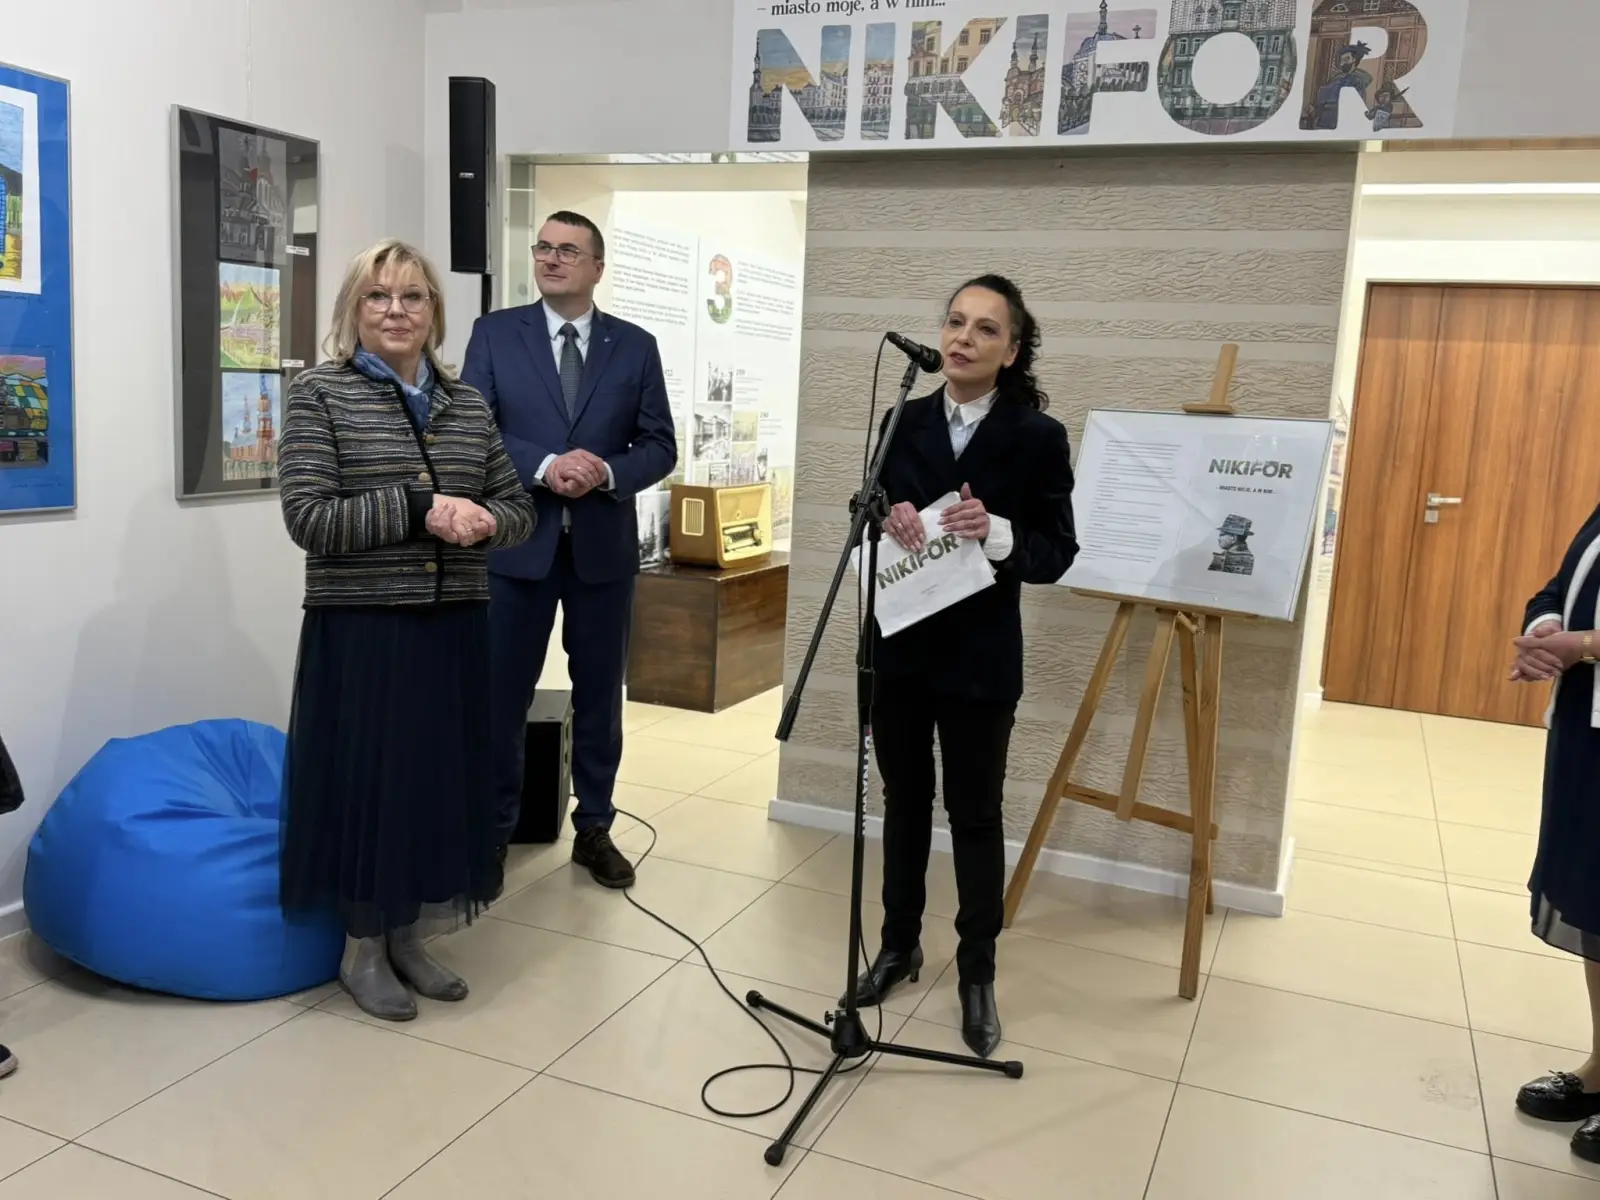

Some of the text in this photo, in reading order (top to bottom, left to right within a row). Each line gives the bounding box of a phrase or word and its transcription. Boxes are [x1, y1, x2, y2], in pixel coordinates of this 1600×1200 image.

[771, 0, 820, 16] miasto
[826, 0, 864, 16] moje,
[870, 0, 879, 10] a
[886, 0, 898, 9] w
[747, 0, 1430, 143] NIKIFOR
[707, 253, 733, 325] 3
[1208, 458, 1293, 479] NIKIFOR
[875, 533, 960, 590] NIKIFOR
